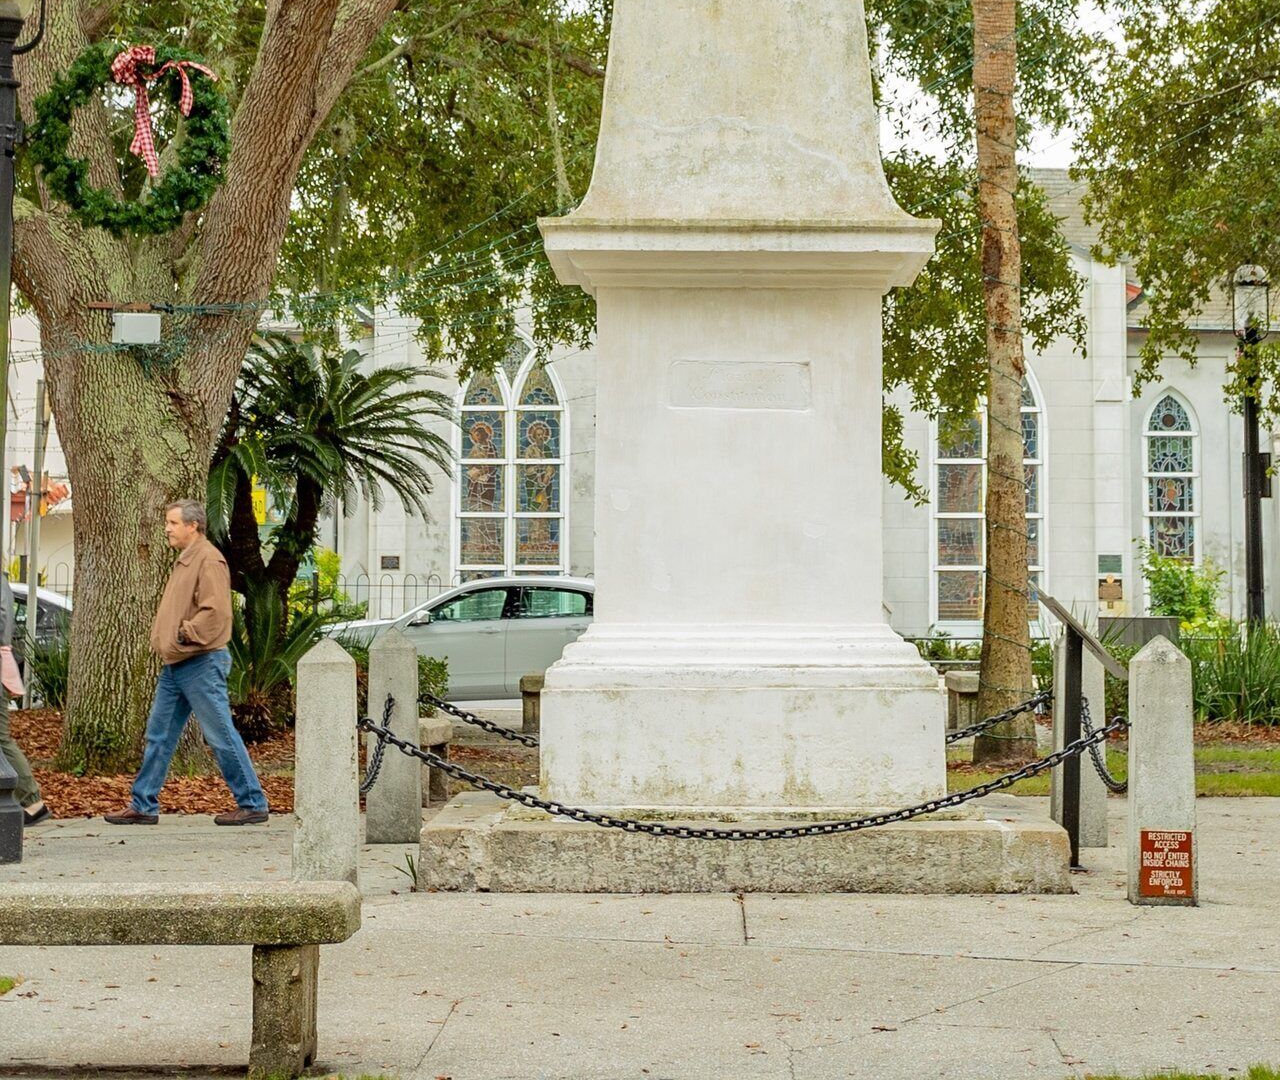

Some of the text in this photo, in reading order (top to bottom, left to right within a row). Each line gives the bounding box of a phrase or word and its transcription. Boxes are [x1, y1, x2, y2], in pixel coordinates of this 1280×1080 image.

[1148, 832, 1187, 841] RESTRICTED
[1154, 840, 1180, 849] ACCESS
[1143, 851, 1189, 861] DO NOT ENTER
[1143, 859, 1190, 868] INSIDE CHAINS
[1150, 870, 1181, 878] STRICTLY
[1149, 878, 1183, 887] ENFORCED
